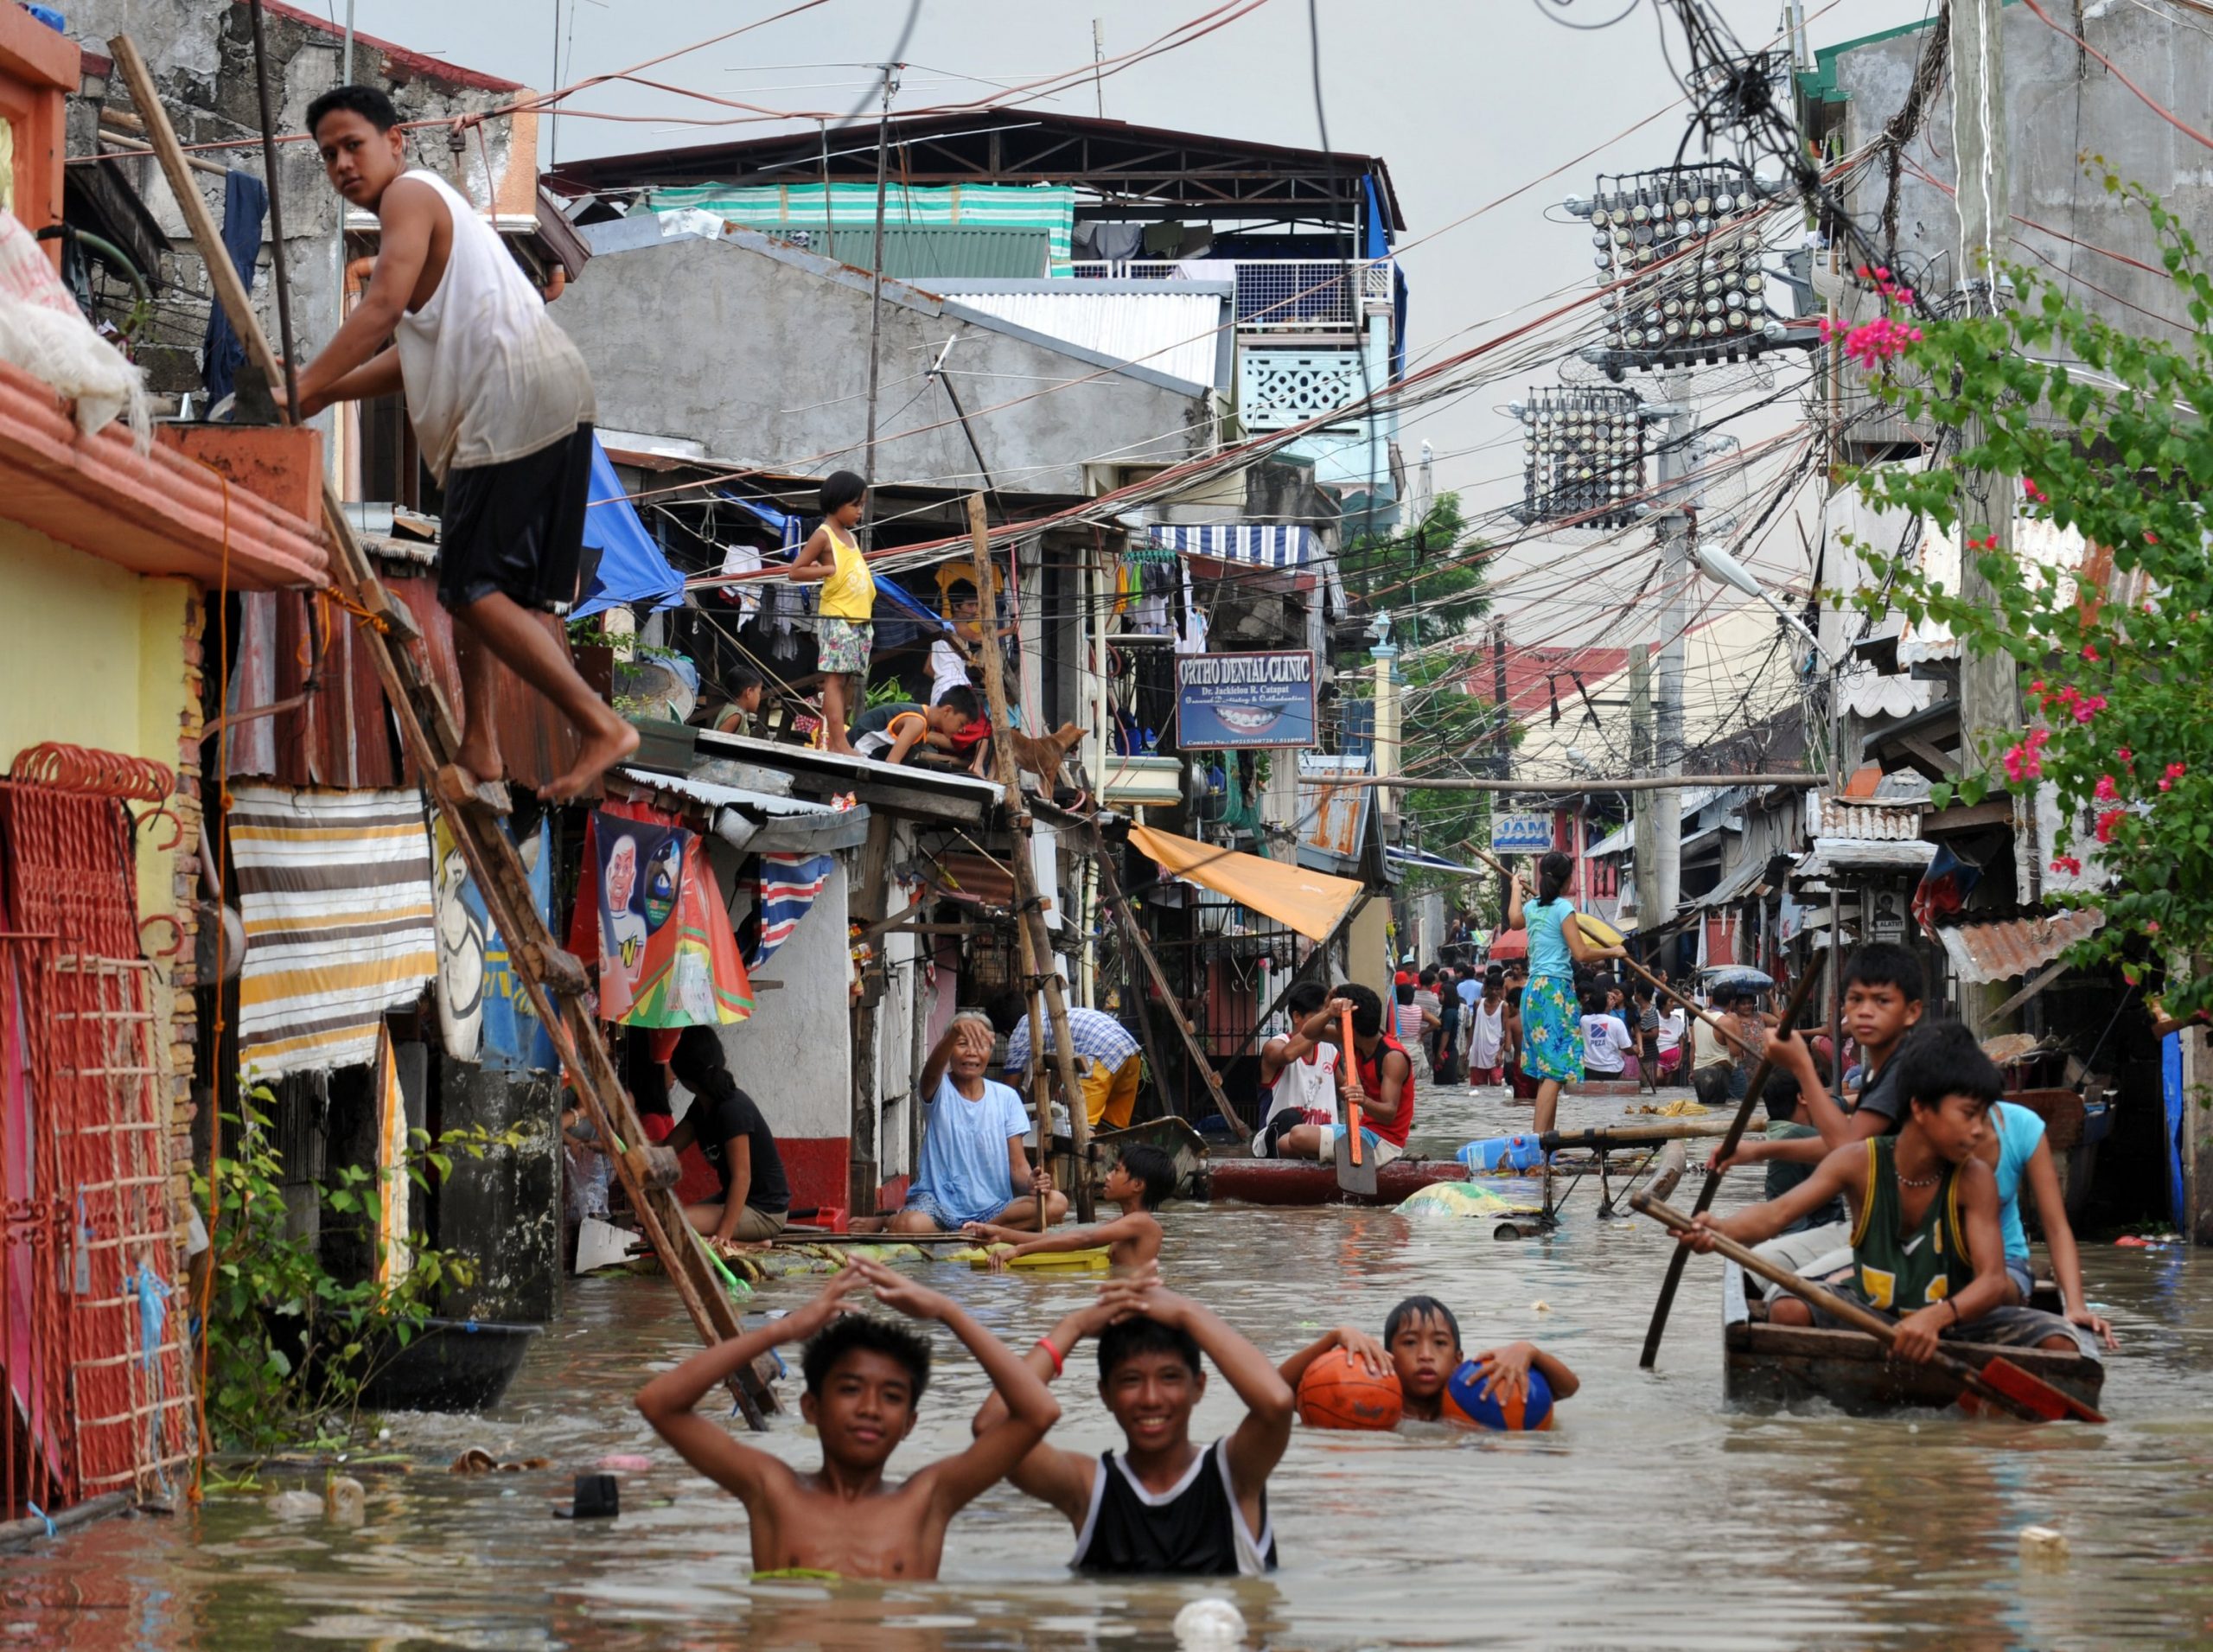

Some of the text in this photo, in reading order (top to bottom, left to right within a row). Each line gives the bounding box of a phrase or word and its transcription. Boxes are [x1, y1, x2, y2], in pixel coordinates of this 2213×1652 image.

[1180, 655, 1311, 685] ORTHO DENTAL CLINIC
[1202, 687, 1213, 696] Dr.
[1250, 686, 1258, 694] R.
[1496, 821, 1547, 834] JAM
